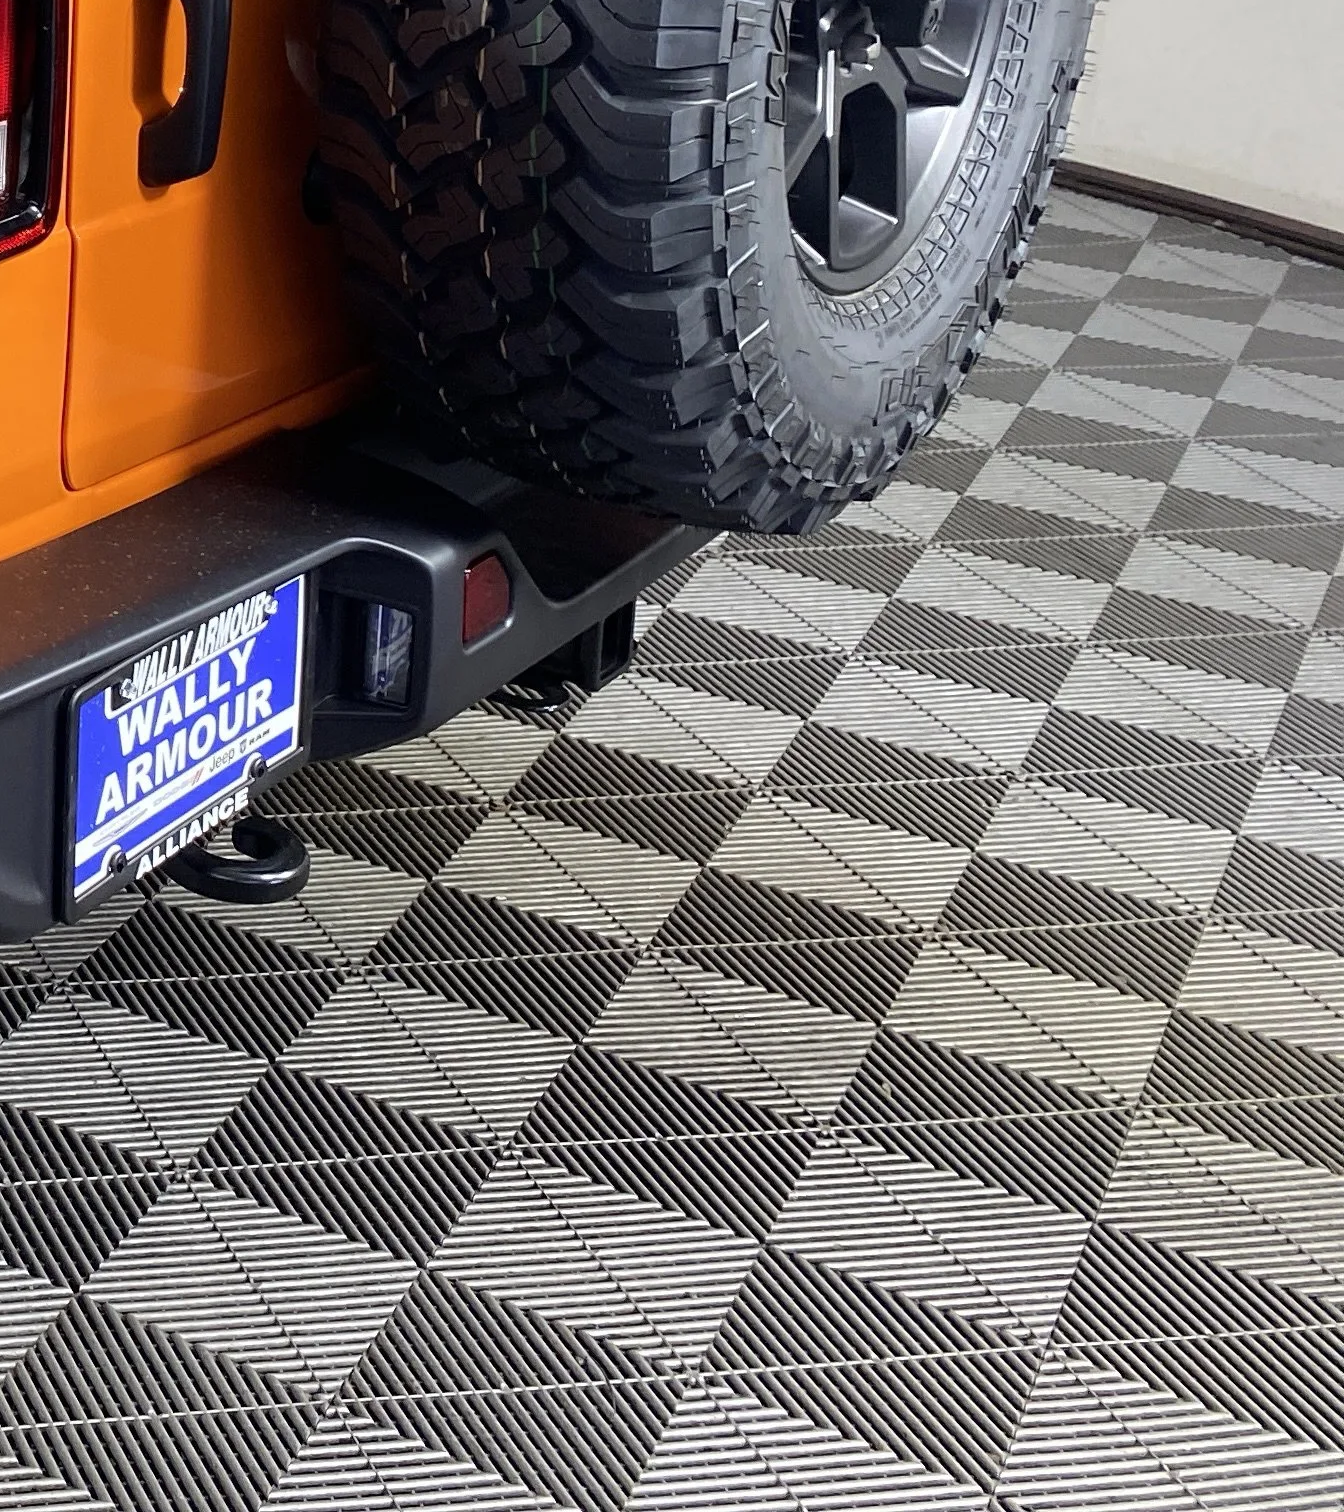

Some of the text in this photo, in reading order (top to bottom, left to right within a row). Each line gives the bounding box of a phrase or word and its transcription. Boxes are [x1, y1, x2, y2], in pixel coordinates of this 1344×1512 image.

[132, 591, 267, 696] WALLY ARMOUR
[117, 637, 257, 756] WALLY
[95, 678, 273, 825] ARMOUR
[208, 748, 235, 774] Jeep
[248, 728, 271, 746] RAM
[135, 786, 249, 880] ALLIANCE
